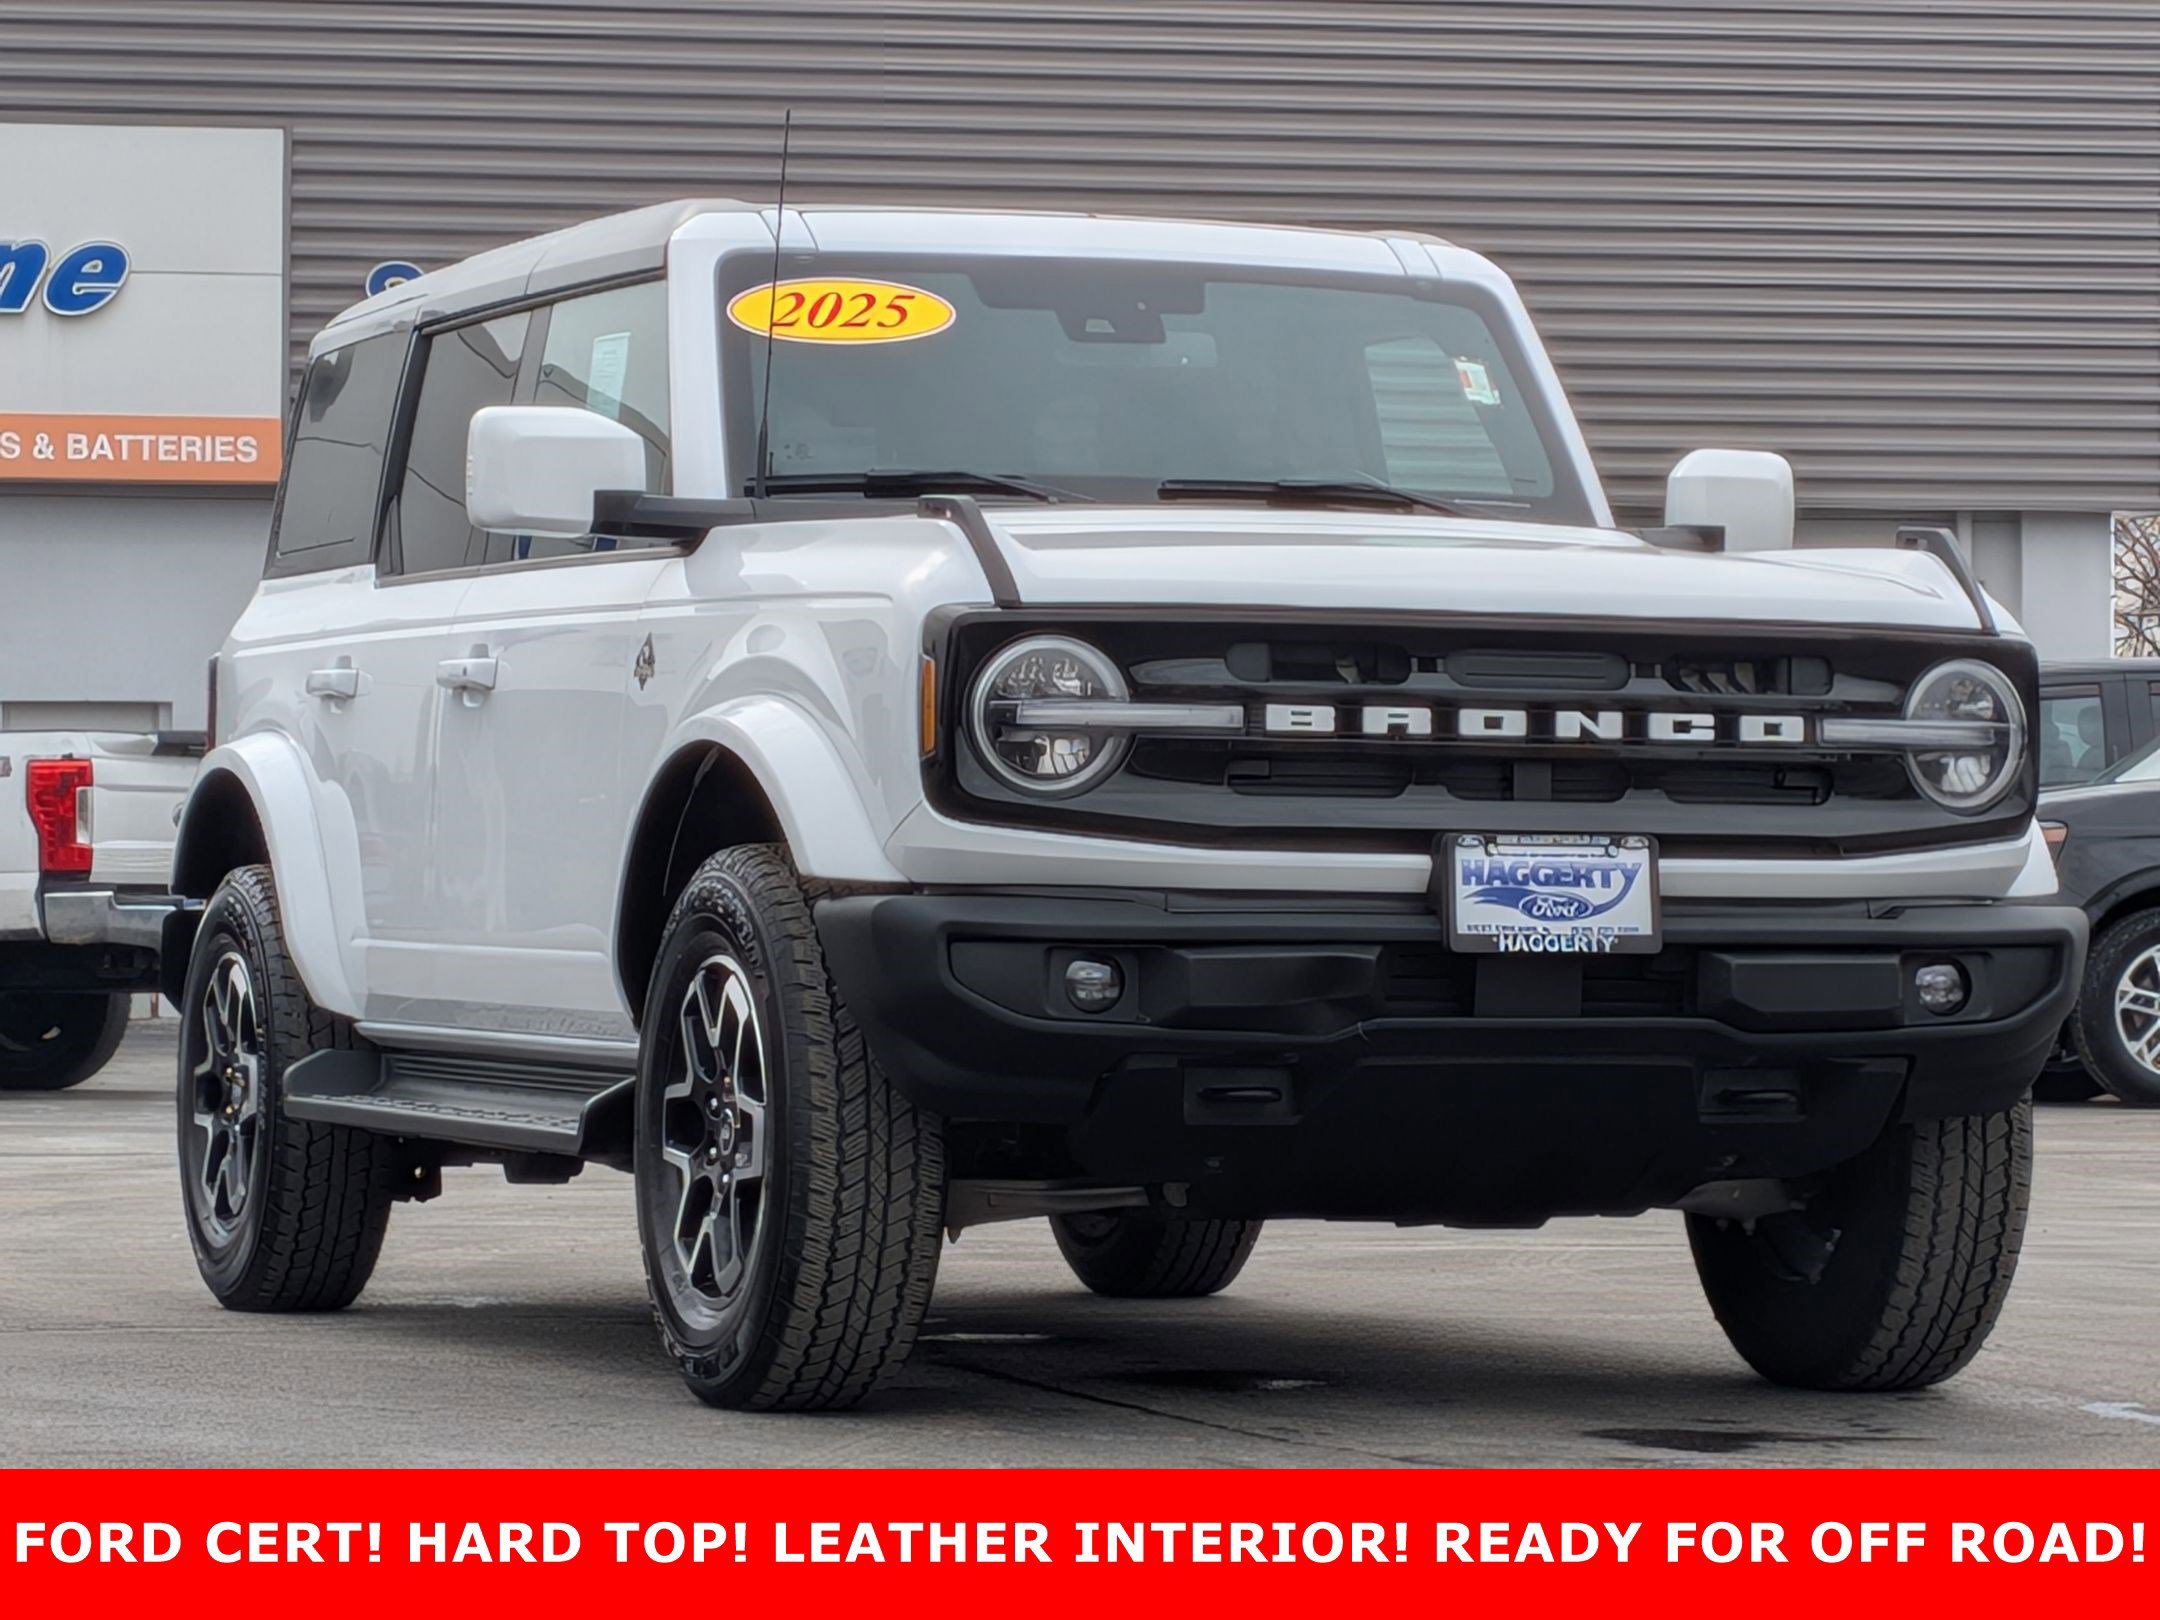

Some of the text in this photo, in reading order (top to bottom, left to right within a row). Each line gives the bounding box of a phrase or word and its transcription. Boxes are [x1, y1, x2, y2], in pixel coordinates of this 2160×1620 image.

[771, 291, 916, 329] 2025
[32, 432, 54, 460] &
[67, 433, 259, 464] BATTERIES
[1265, 703, 1805, 743] BRONCO
[1460, 858, 1642, 894] HAGGERTY
[1499, 931, 1615, 953] HAGGERTY
